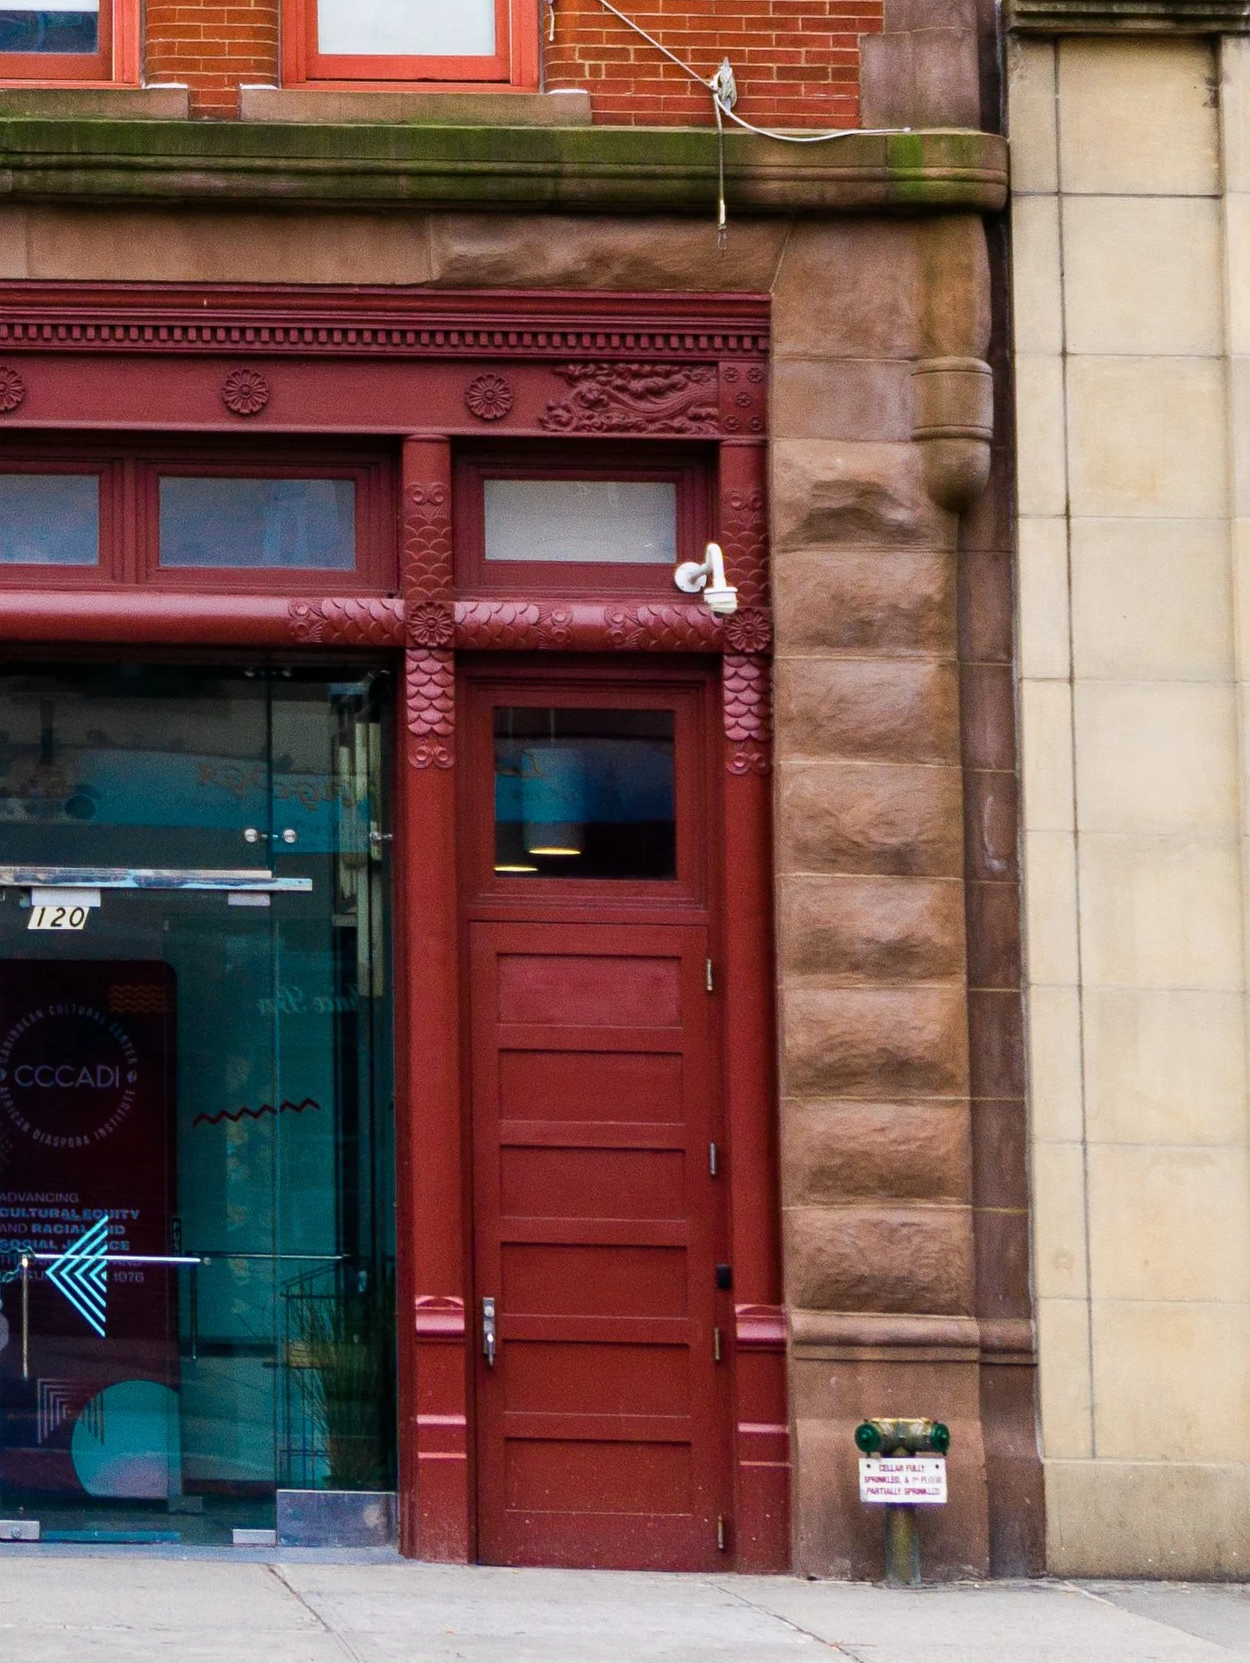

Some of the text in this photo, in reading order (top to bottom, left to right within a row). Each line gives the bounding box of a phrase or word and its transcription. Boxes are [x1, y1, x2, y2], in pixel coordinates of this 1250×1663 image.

[36, 906, 86, 928] 120
[14, 1064, 120, 1088] CCCADI
[82, 1208, 140, 1220] EQUITY
[879, 1464, 925, 1472] CELLAR FULLY
[866, 1487, 901, 1495] PARTIALLY
